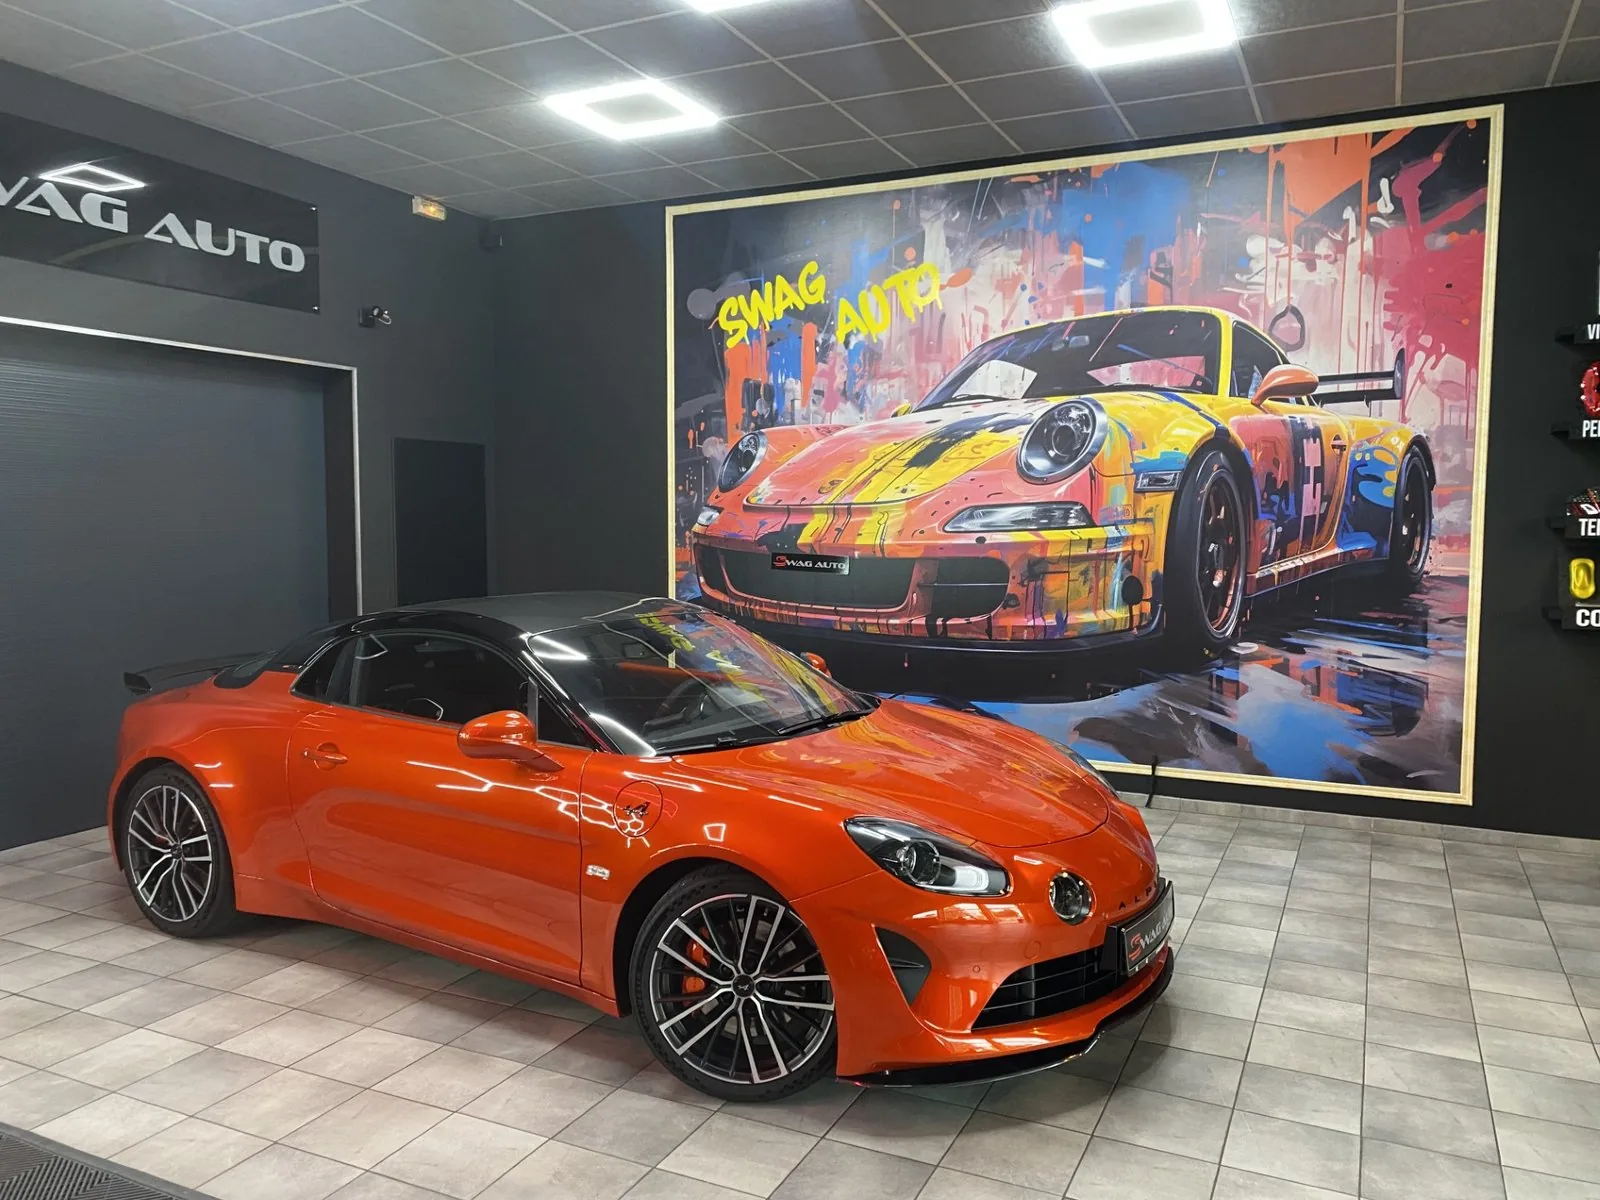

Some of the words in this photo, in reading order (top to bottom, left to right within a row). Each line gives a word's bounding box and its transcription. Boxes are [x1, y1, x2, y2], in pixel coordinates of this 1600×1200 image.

[144, 212, 305, 273] AUTO
[717, 260, 827, 349] SWAG
[835, 262, 943, 344] AUTO
[1582, 419, 1600, 438] PE
[773, 555, 812, 568] SWAG
[1118, 882, 1156, 910] ALP
